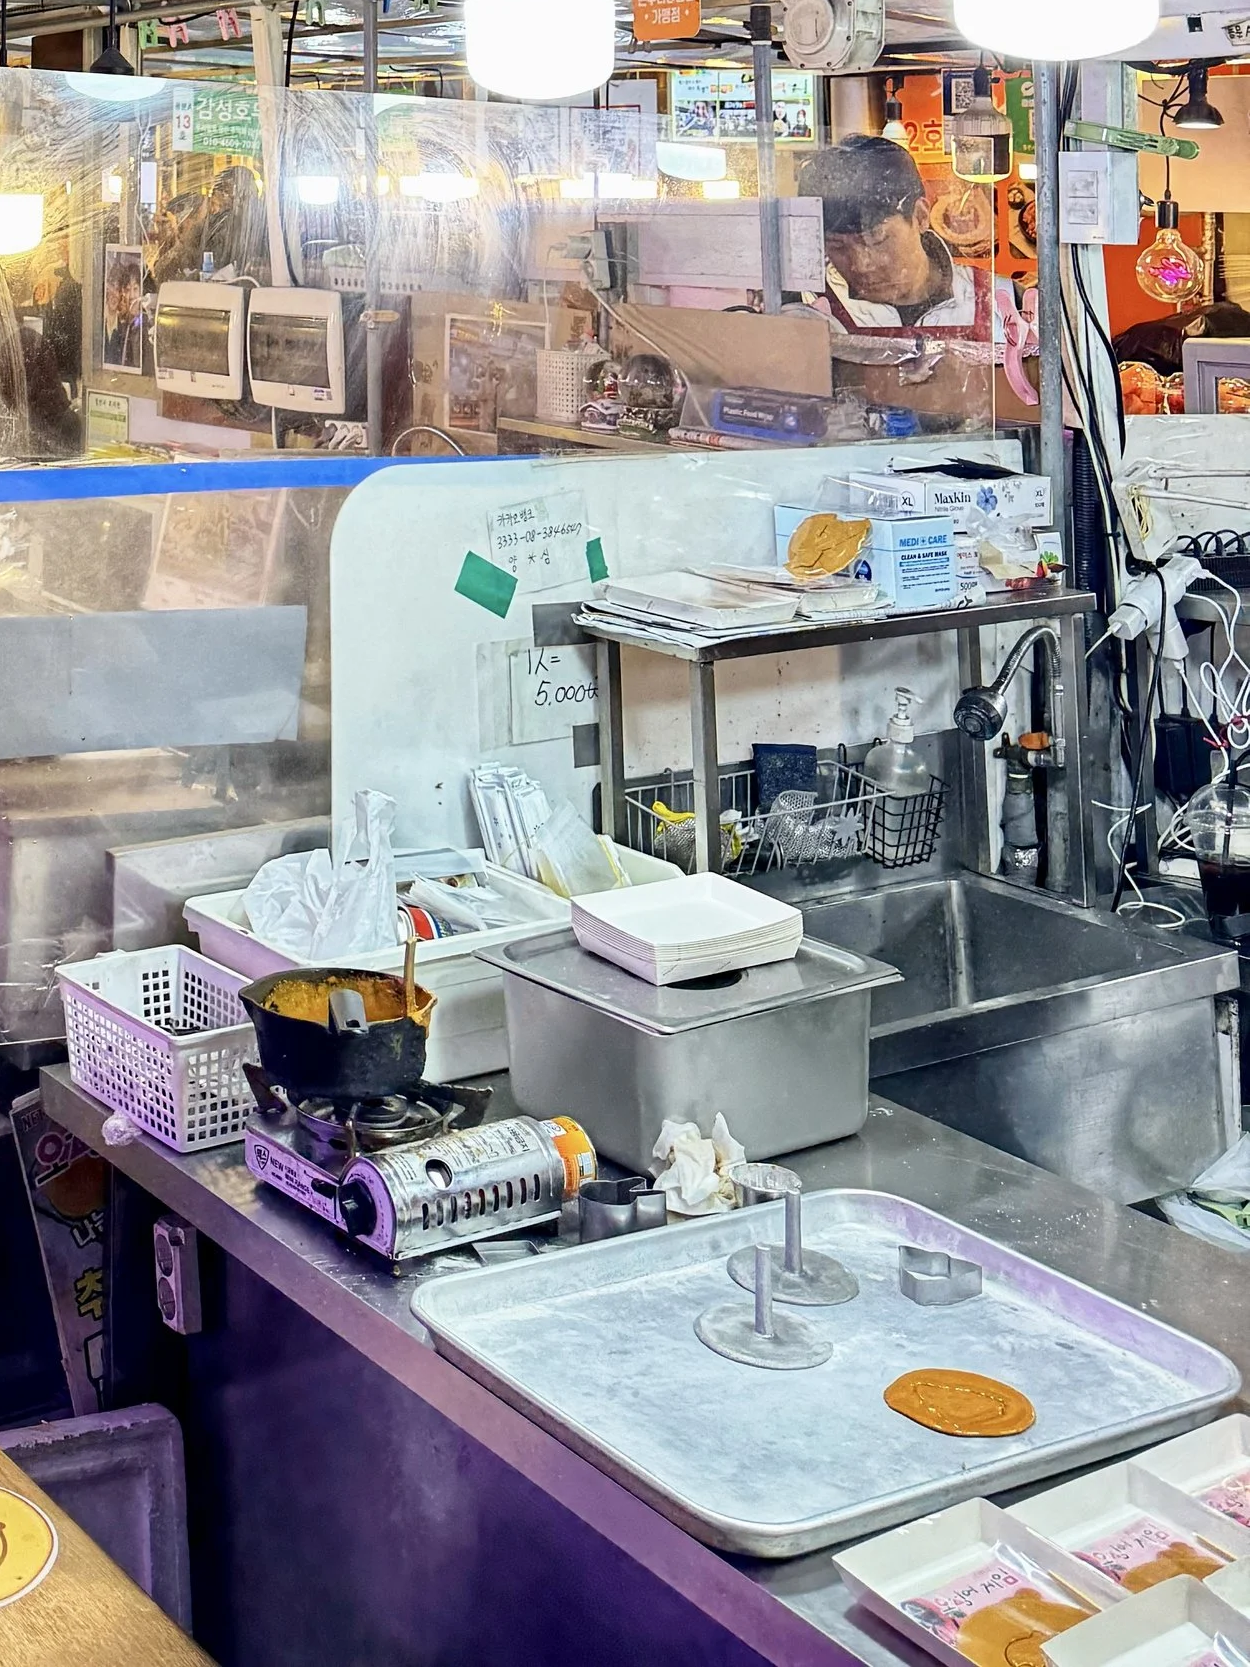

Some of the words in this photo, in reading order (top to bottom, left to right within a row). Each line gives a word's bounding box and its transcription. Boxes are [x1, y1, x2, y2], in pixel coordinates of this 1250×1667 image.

[176, 115, 191, 129] 13
[934, 491, 971, 505] MaxKin
[1035, 490, 1044, 498] XL
[902, 495, 914, 508] XL
[899, 537, 918, 548] MEDI
[928, 534, 947, 545] CARE
[901, 552, 915, 561] CLEAN
[922, 551, 933, 559] SAFE
[270, 1157, 284, 1171] NEW
